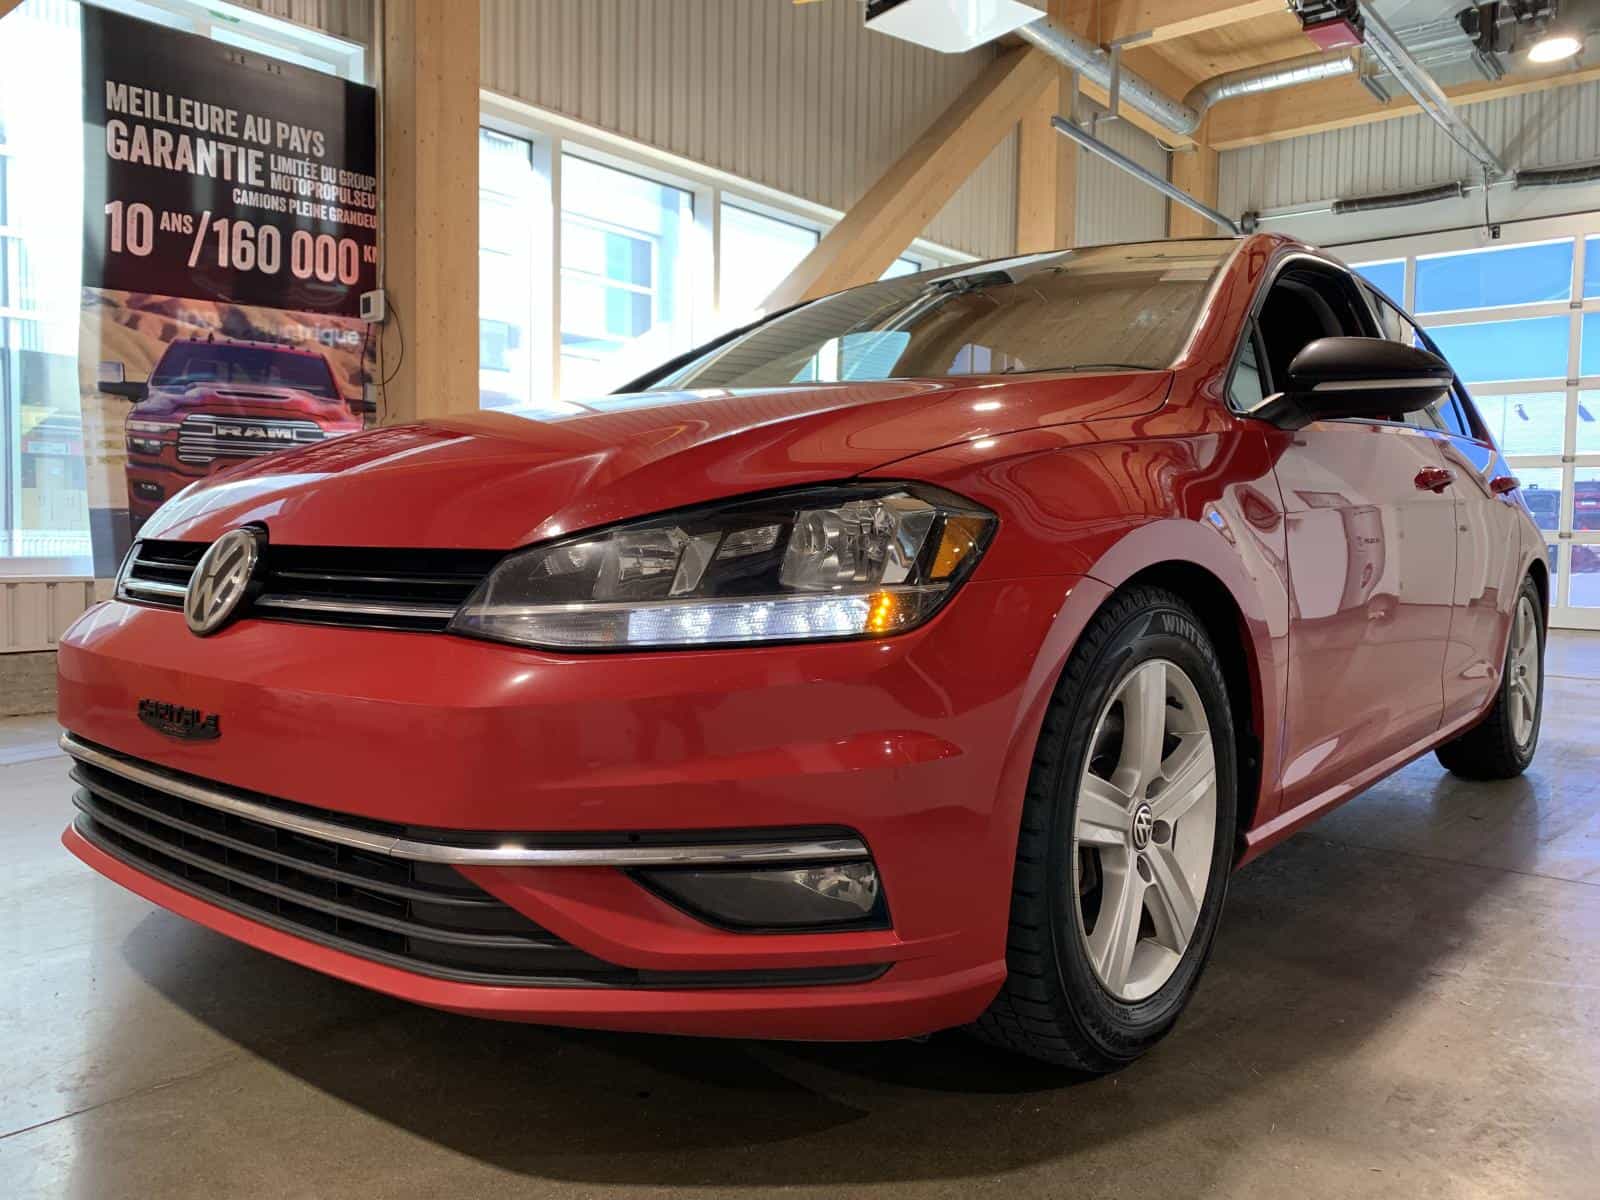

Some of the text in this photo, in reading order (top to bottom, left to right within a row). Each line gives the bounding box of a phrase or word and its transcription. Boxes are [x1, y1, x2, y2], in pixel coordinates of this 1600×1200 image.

[105, 80, 325, 157] MEILLEURE AU PAYS
[105, 119, 265, 187] GARANTIE
[270, 153, 318, 181] LIMITÉE
[321, 165, 337, 184] DU
[232, 188, 287, 214] CAMIONS
[289, 198, 328, 221] PLEINE
[104, 200, 154, 257] 10
[291, 229, 359, 286] 000
[217, 424, 293, 440] RAM
